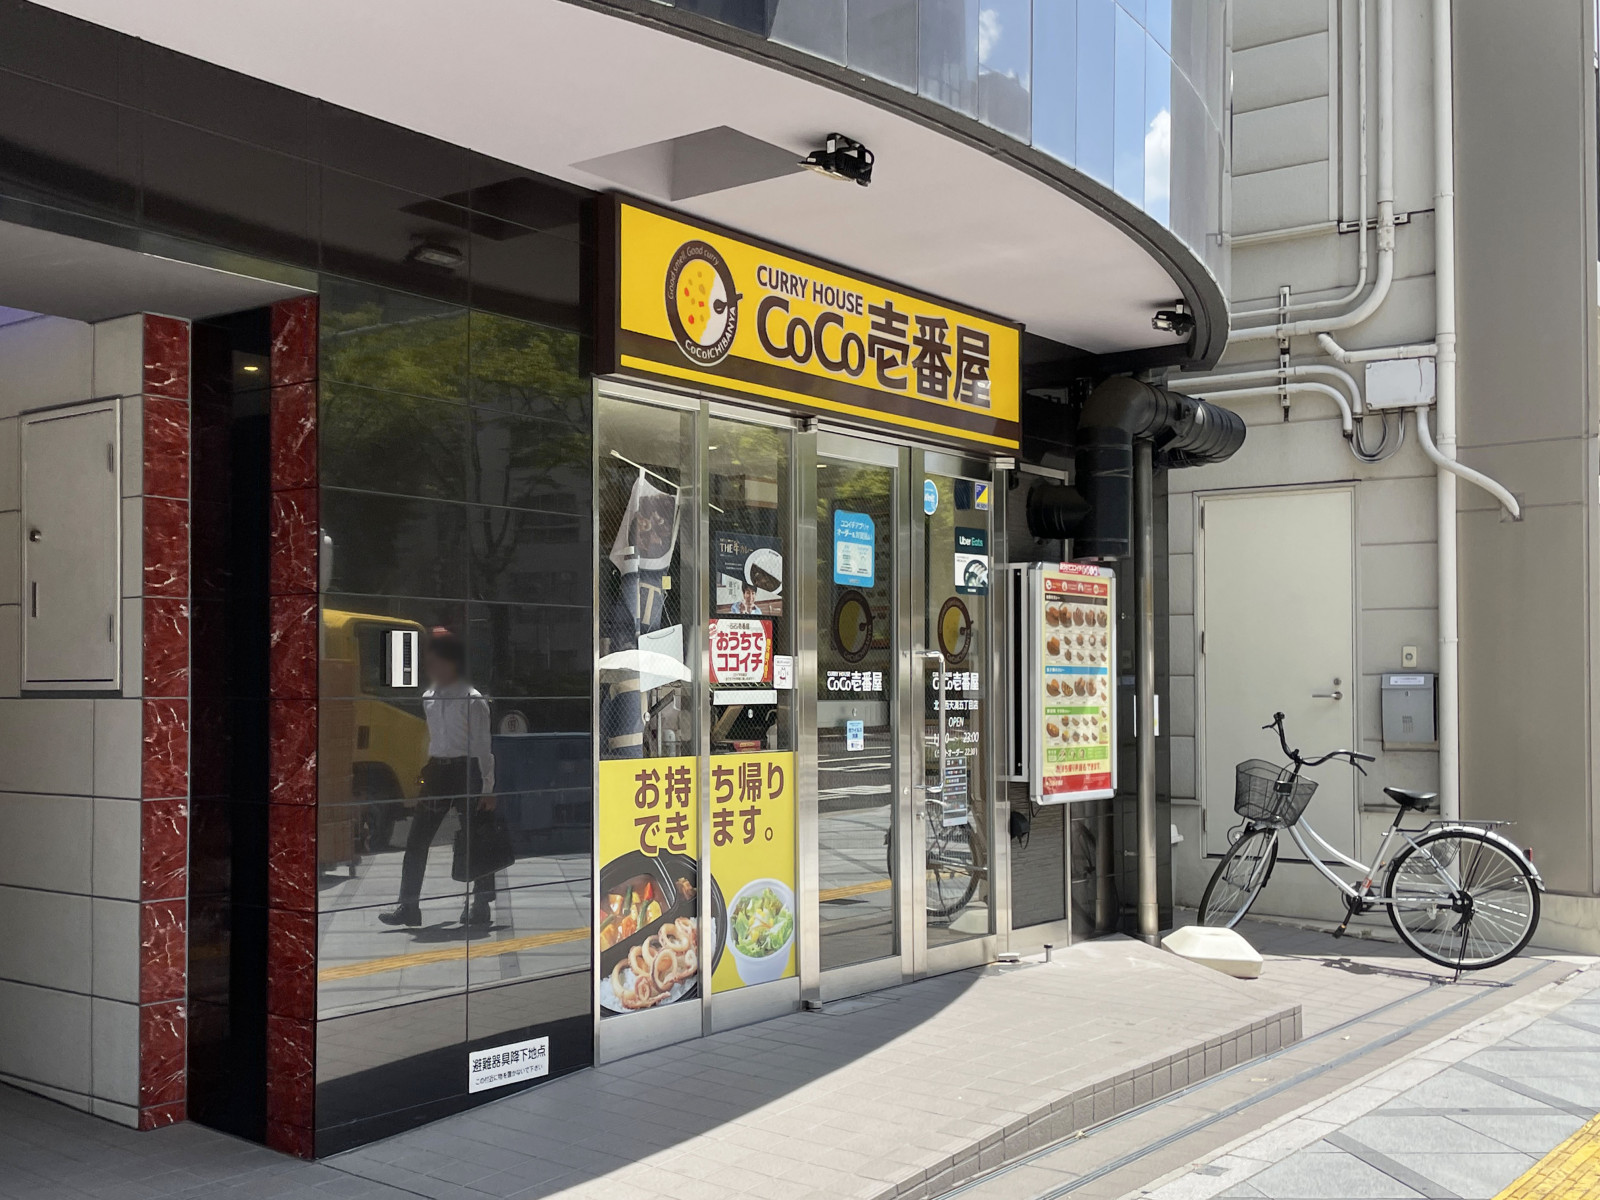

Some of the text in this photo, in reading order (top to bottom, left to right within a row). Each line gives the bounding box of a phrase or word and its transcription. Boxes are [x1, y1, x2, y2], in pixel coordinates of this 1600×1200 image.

[686, 246, 704, 258] Good
[703, 250, 719, 266] curry
[757, 265, 863, 316] CURRY HOUSE
[756, 295, 991, 409] CoCo壱番屋
[959, 535, 983, 547] Uber Eats
[716, 631, 764, 651] おうちで
[717, 653, 763, 672] ココイチ
[827, 670, 883, 692] CoCo壱番屋
[948, 716, 965, 728] OPEN
[472, 1045, 546, 1073] 避難器具降下地点
